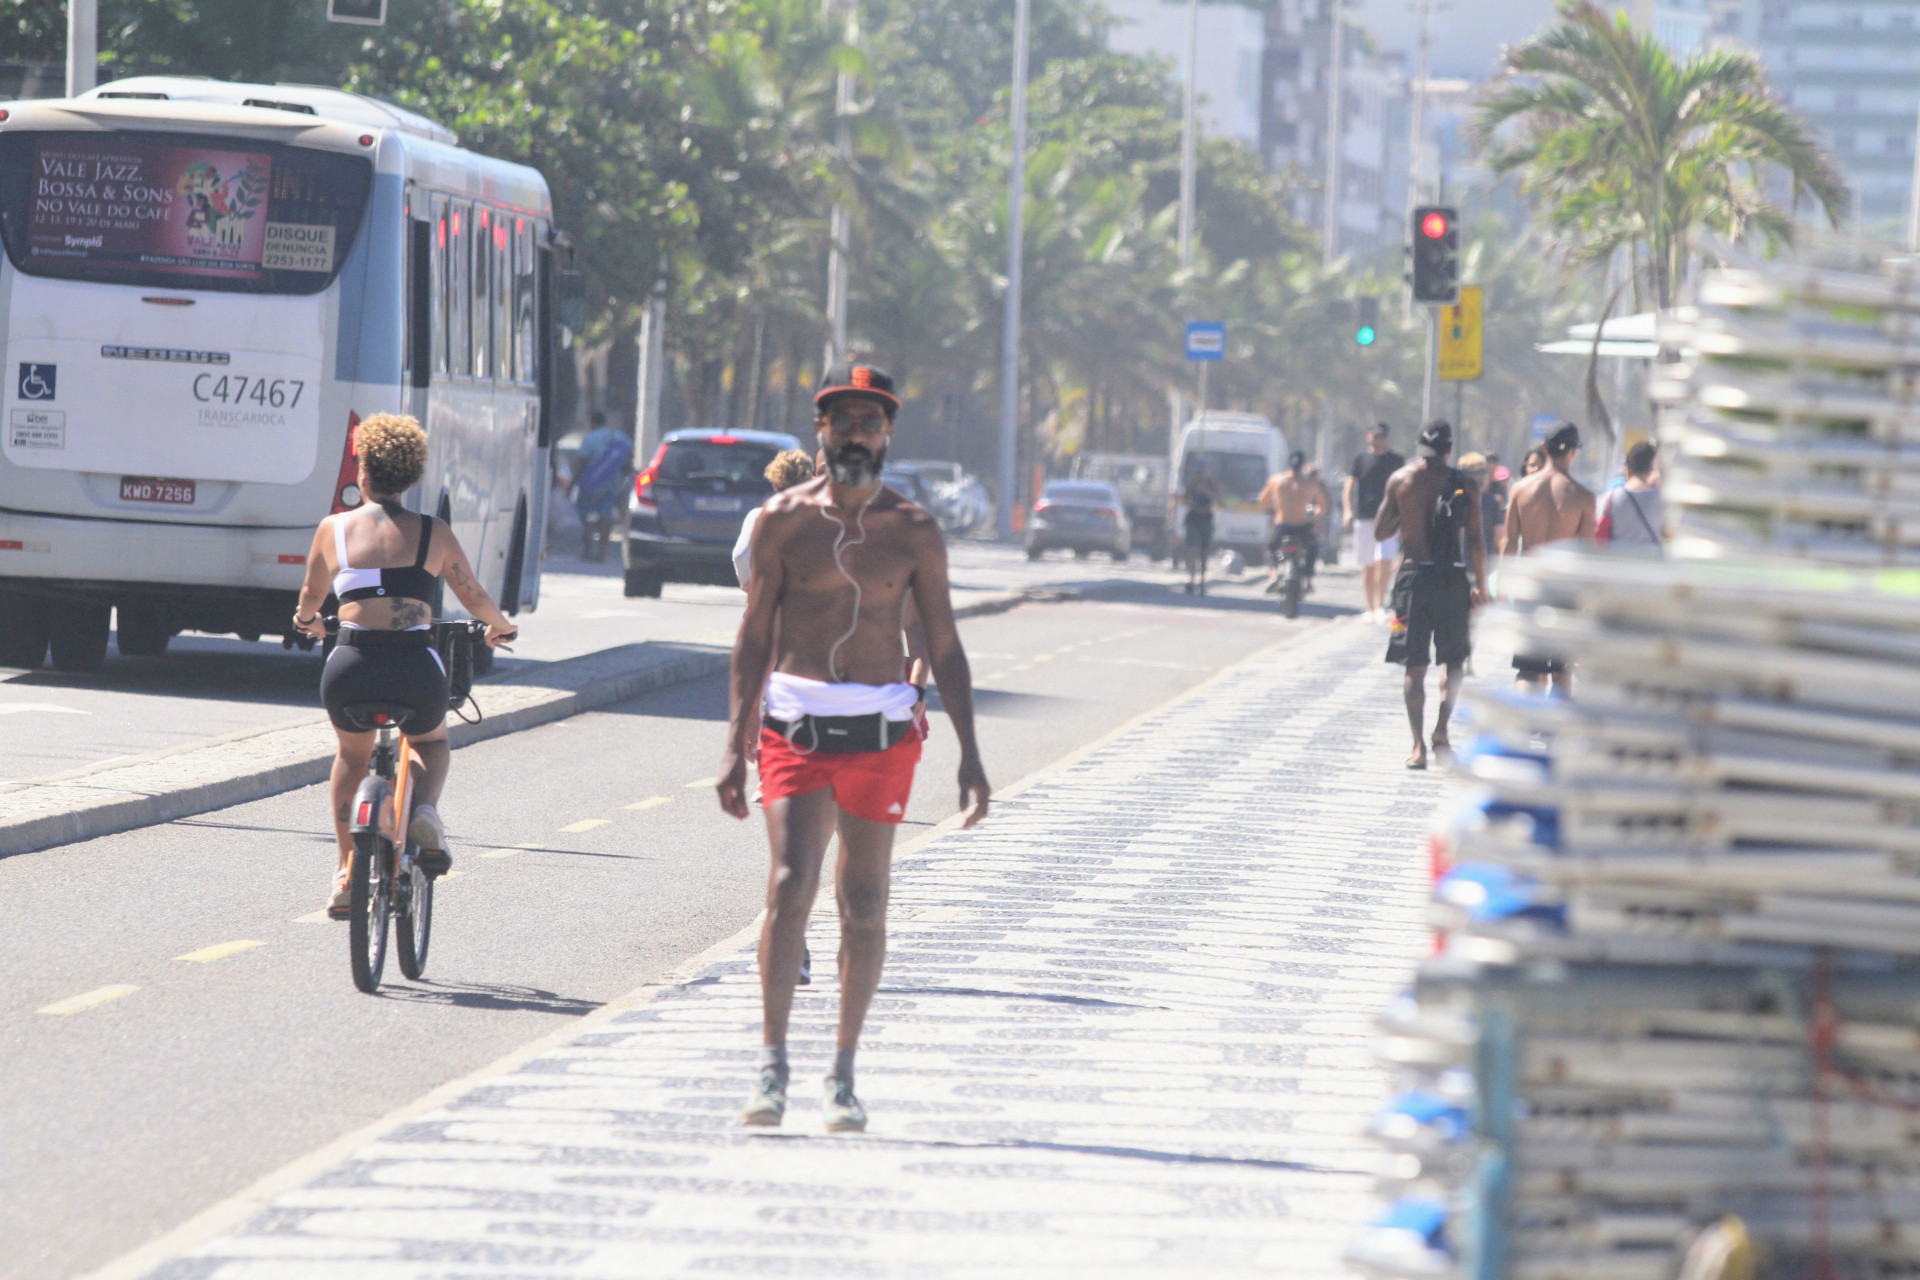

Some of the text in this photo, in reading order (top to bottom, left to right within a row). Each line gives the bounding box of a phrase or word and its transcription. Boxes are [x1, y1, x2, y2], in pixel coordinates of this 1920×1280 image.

[42, 158, 87, 178] VALE
[38, 178, 173, 204] BOSSA & SONS
[36, 199, 63, 214] NO
[68, 200, 101, 216] VALE
[108, 203, 130, 218] DO
[267, 226, 330, 243] DISQUE
[265, 254, 326, 268] 2253-1177
[193, 373, 305, 409] C47467
[198, 409, 286, 426] TRANSCARIOCA
